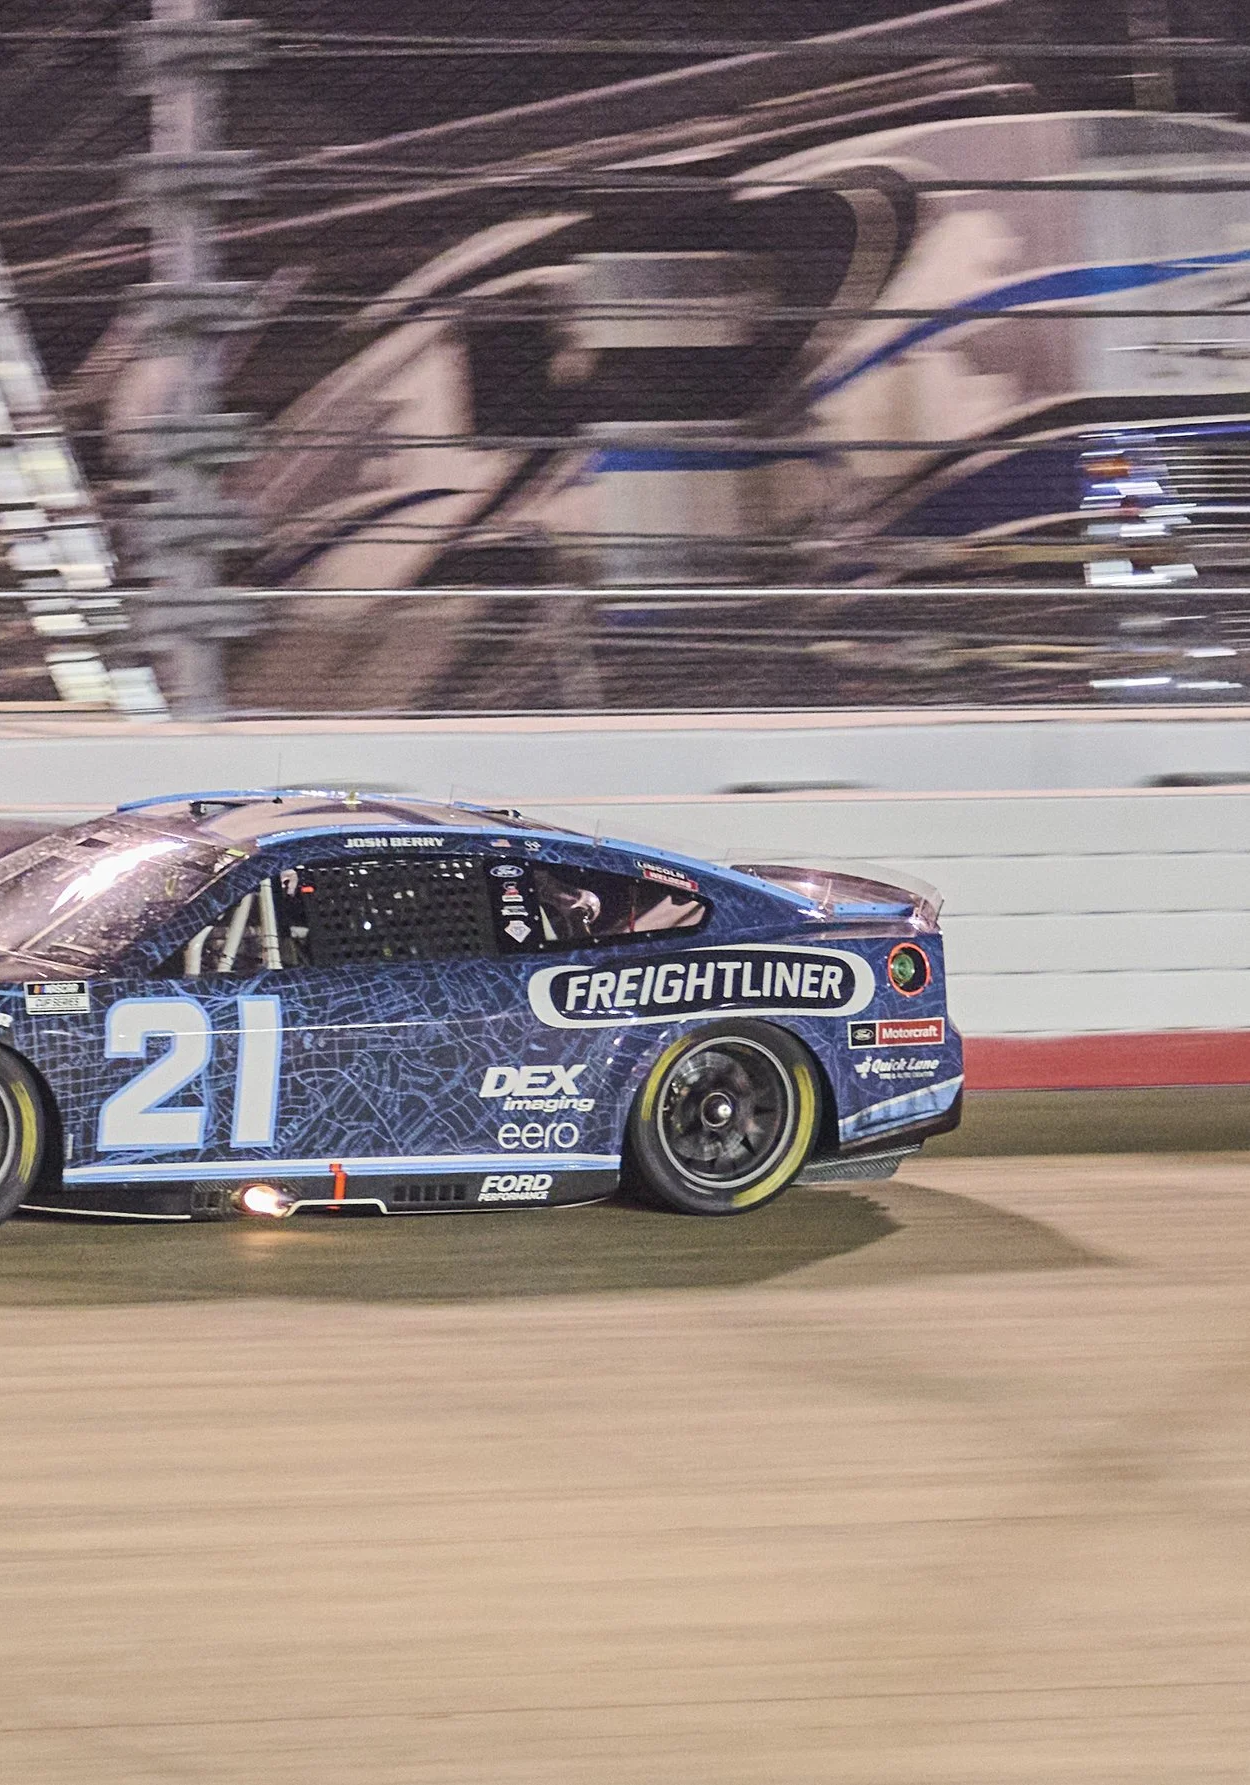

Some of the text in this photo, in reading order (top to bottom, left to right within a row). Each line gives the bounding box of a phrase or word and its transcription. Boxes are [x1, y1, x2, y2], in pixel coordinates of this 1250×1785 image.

[344, 836, 445, 848] JOSH BERRY
[636, 860, 686, 880] LINCOLN
[565, 961, 843, 1011] FREIGHTLINER
[882, 1025, 938, 1039] Motorcraft
[97, 995, 283, 1151] 21
[871, 1057, 940, 1074] Quick Lane
[479, 1064, 587, 1098] DEX
[503, 1095, 595, 1112] imaging
[498, 1122, 579, 1149] eero
[480, 1174, 553, 1193] FORD
[478, 1190, 549, 1202] PERFORMANCE
